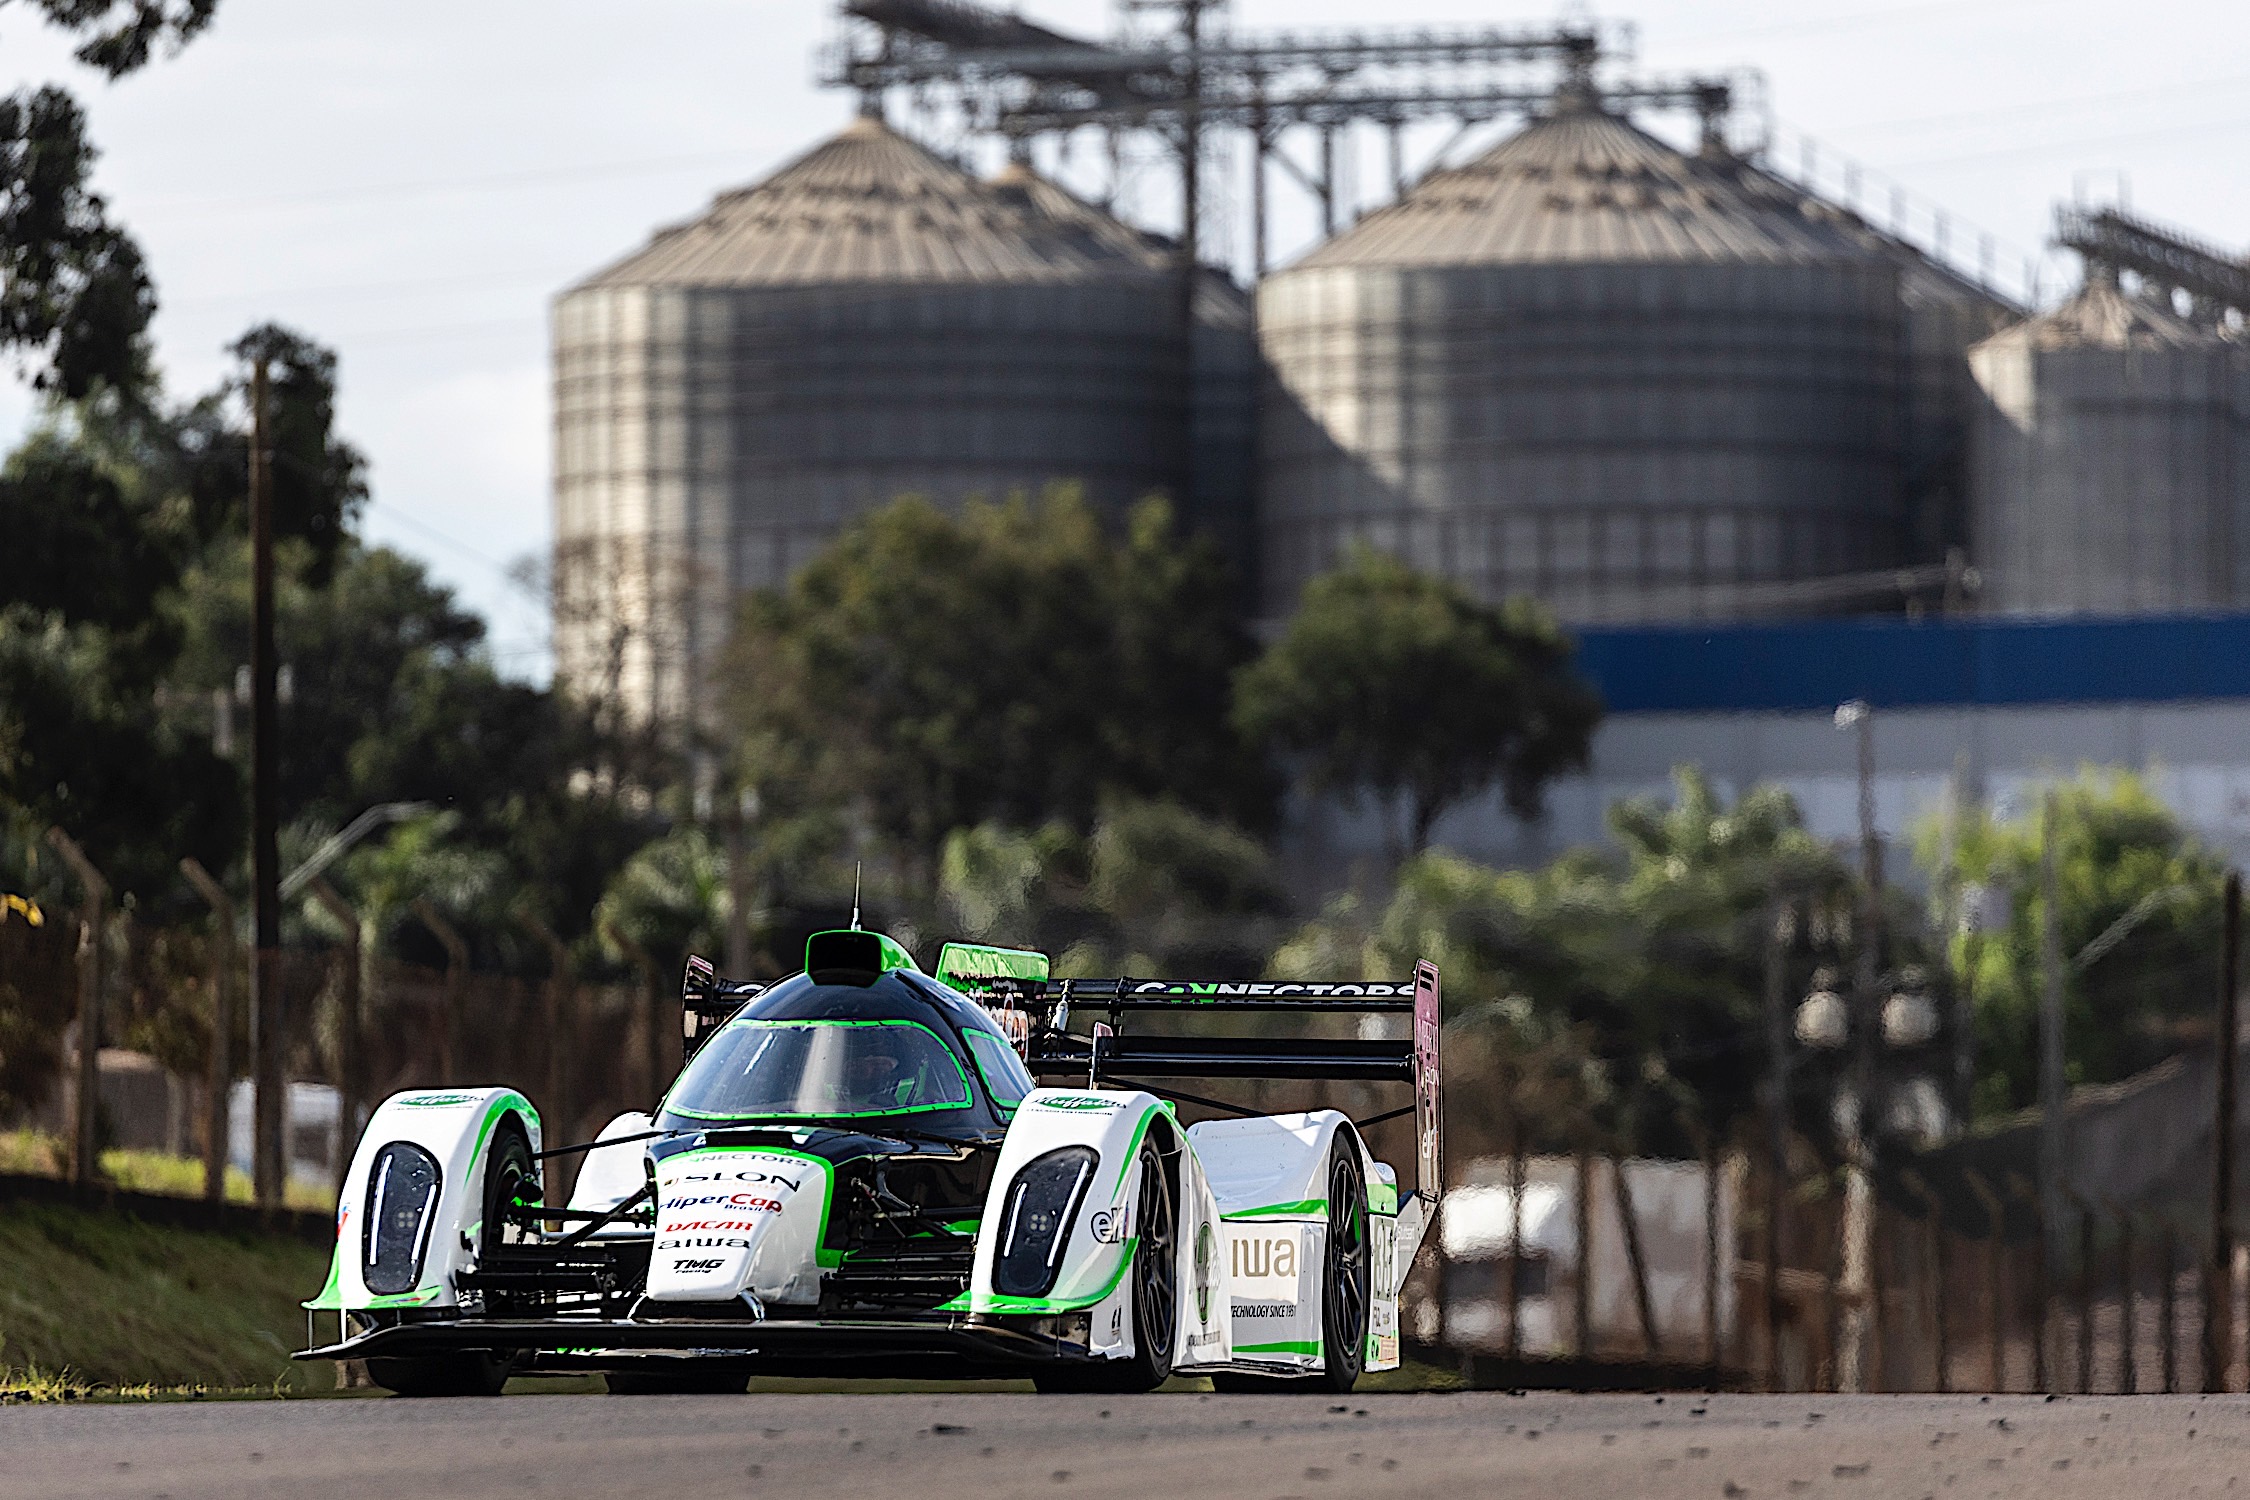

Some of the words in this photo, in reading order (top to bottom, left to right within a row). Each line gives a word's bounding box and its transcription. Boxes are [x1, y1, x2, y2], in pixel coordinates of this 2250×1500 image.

[685, 1172, 801, 1192] SLON
[724, 1204, 763, 1212] Brasil
[665, 1221, 753, 1232] DACAR
[673, 1259, 726, 1269] TMG
[1269, 1305, 1286, 1318] SINCE
